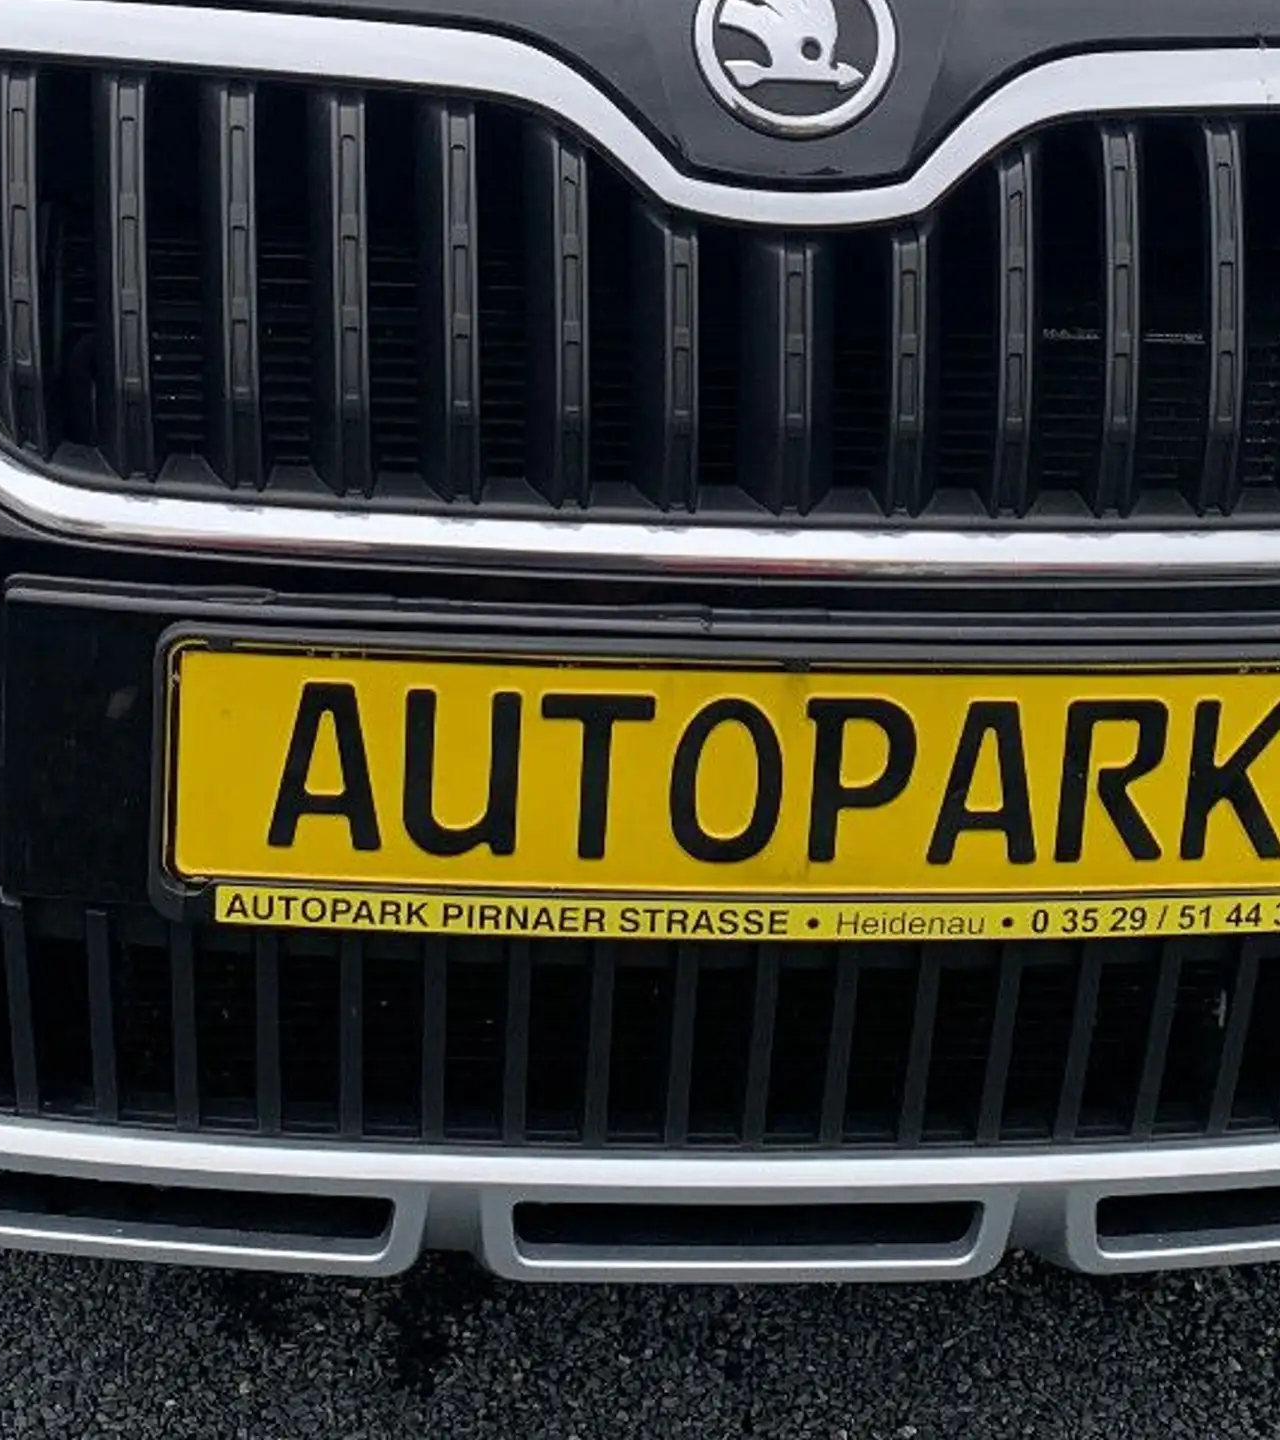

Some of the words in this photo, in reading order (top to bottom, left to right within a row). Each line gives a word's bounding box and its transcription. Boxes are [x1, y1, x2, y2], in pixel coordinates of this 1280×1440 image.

[224, 893, 428, 927] AUTOPARK
[441, 903, 607, 933] PIRNAER
[618, 907, 790, 936] STRASSE
[835, 912, 986, 936] Heidenau
[1031, 909, 1049, 934] 0
[1061, 907, 1099, 934] 35
[1109, 906, 1148, 932] 29
[1177, 905, 1214, 931] 51
[1225, 902, 1263, 928] 44
